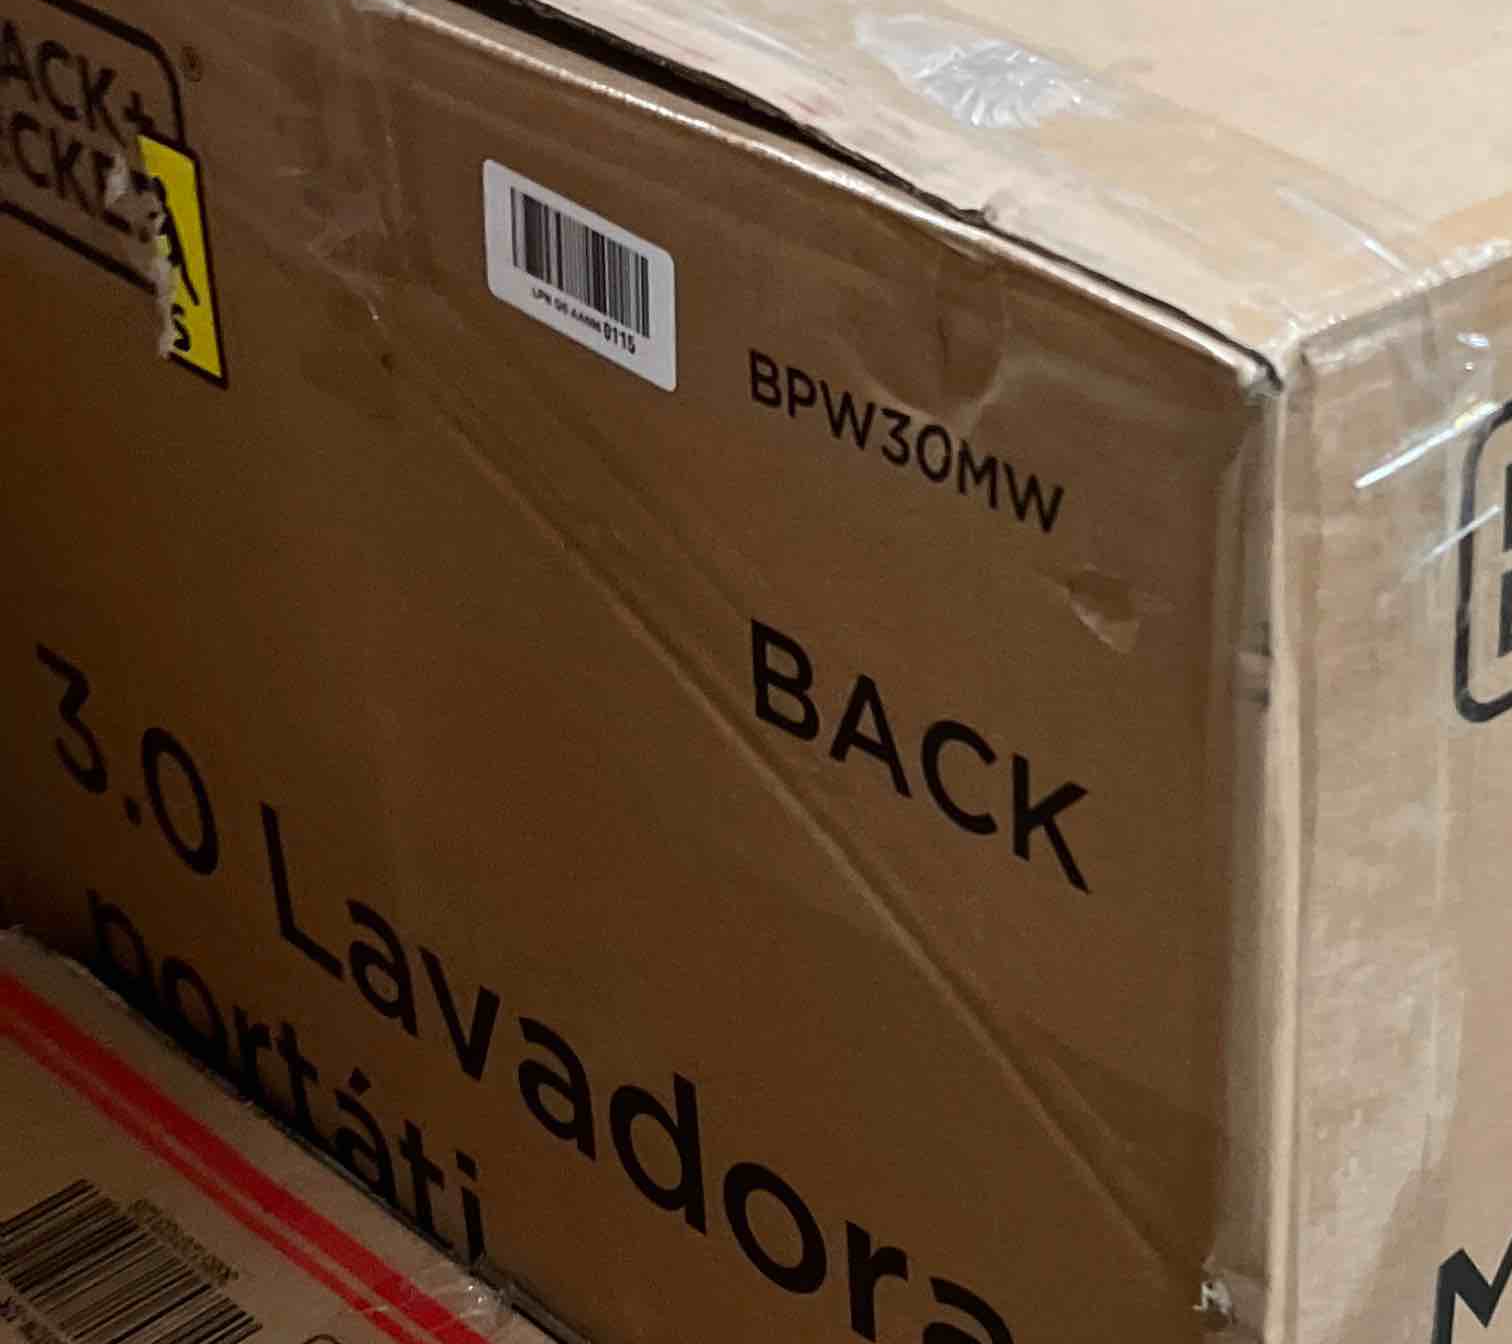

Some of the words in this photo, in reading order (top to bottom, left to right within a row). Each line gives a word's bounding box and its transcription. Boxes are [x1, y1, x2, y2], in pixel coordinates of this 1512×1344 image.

[748, 348, 1065, 535] BPW30MW
[36, 642, 222, 878] 3.0
[750, 617, 1093, 896] BACK
